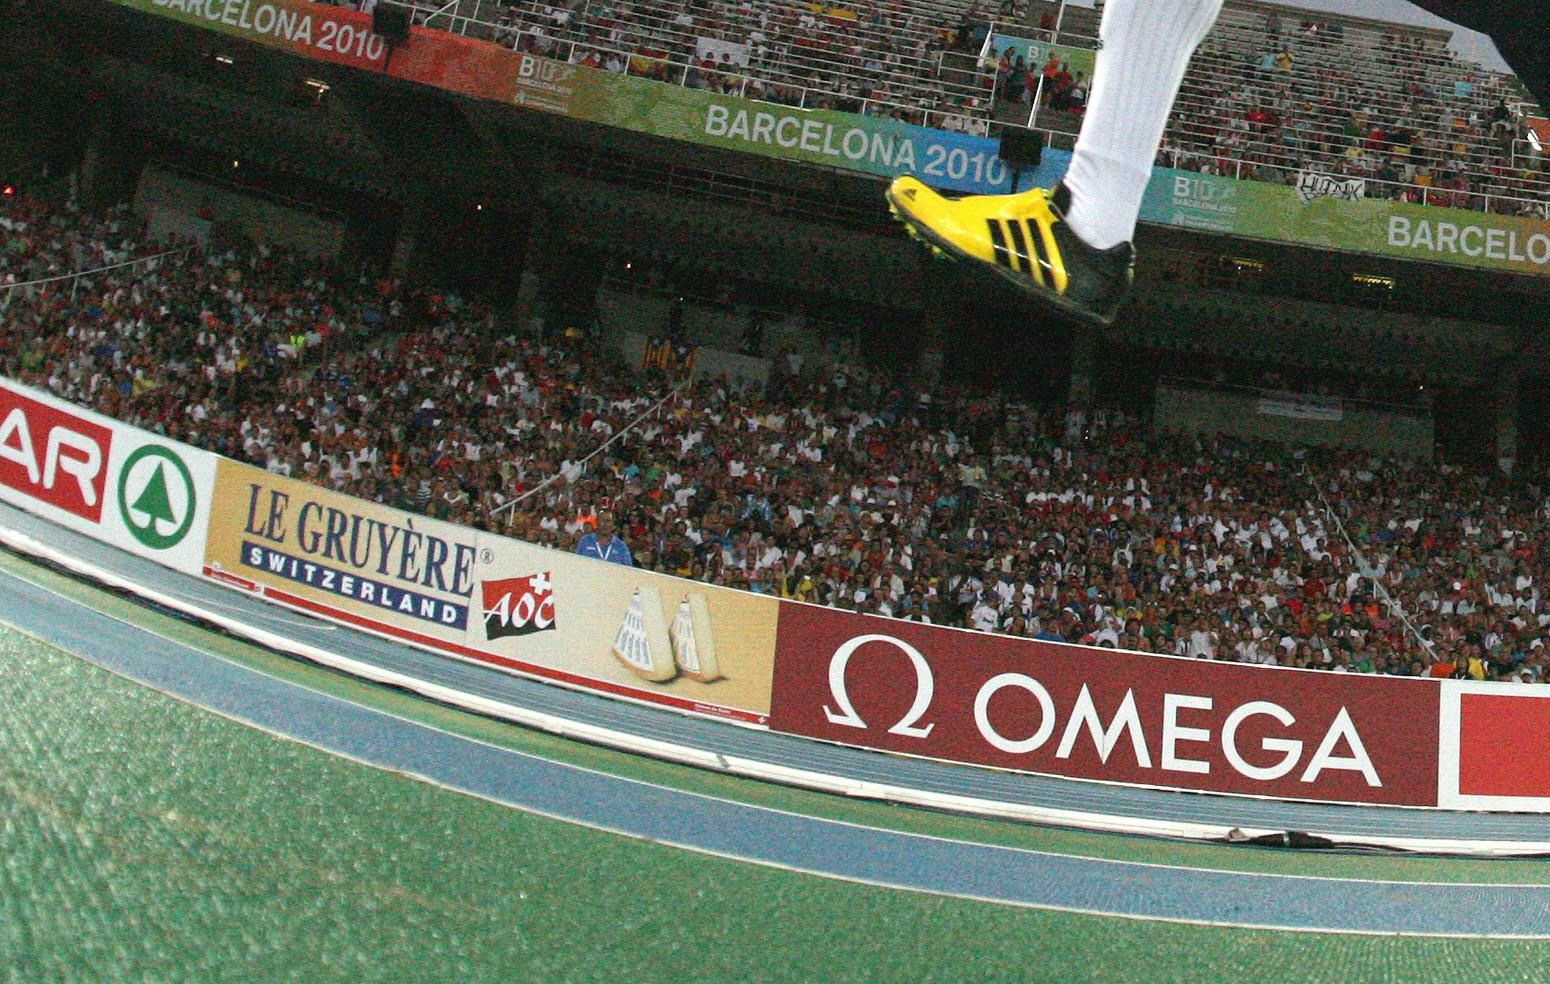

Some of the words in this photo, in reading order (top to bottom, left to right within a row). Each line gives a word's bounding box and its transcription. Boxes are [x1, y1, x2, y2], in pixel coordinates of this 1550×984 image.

[318, 21, 385, 61] 2010
[704, 104, 917, 173] BARCELONA
[924, 143, 1007, 186] 2010
[243, 482, 289, 544] LE
[297, 500, 479, 599] GRUYÈRE
[250, 547, 457, 624] SWITZERLAND
[482, 590, 556, 630] AOC
[974, 672, 1382, 788] OMEGA
